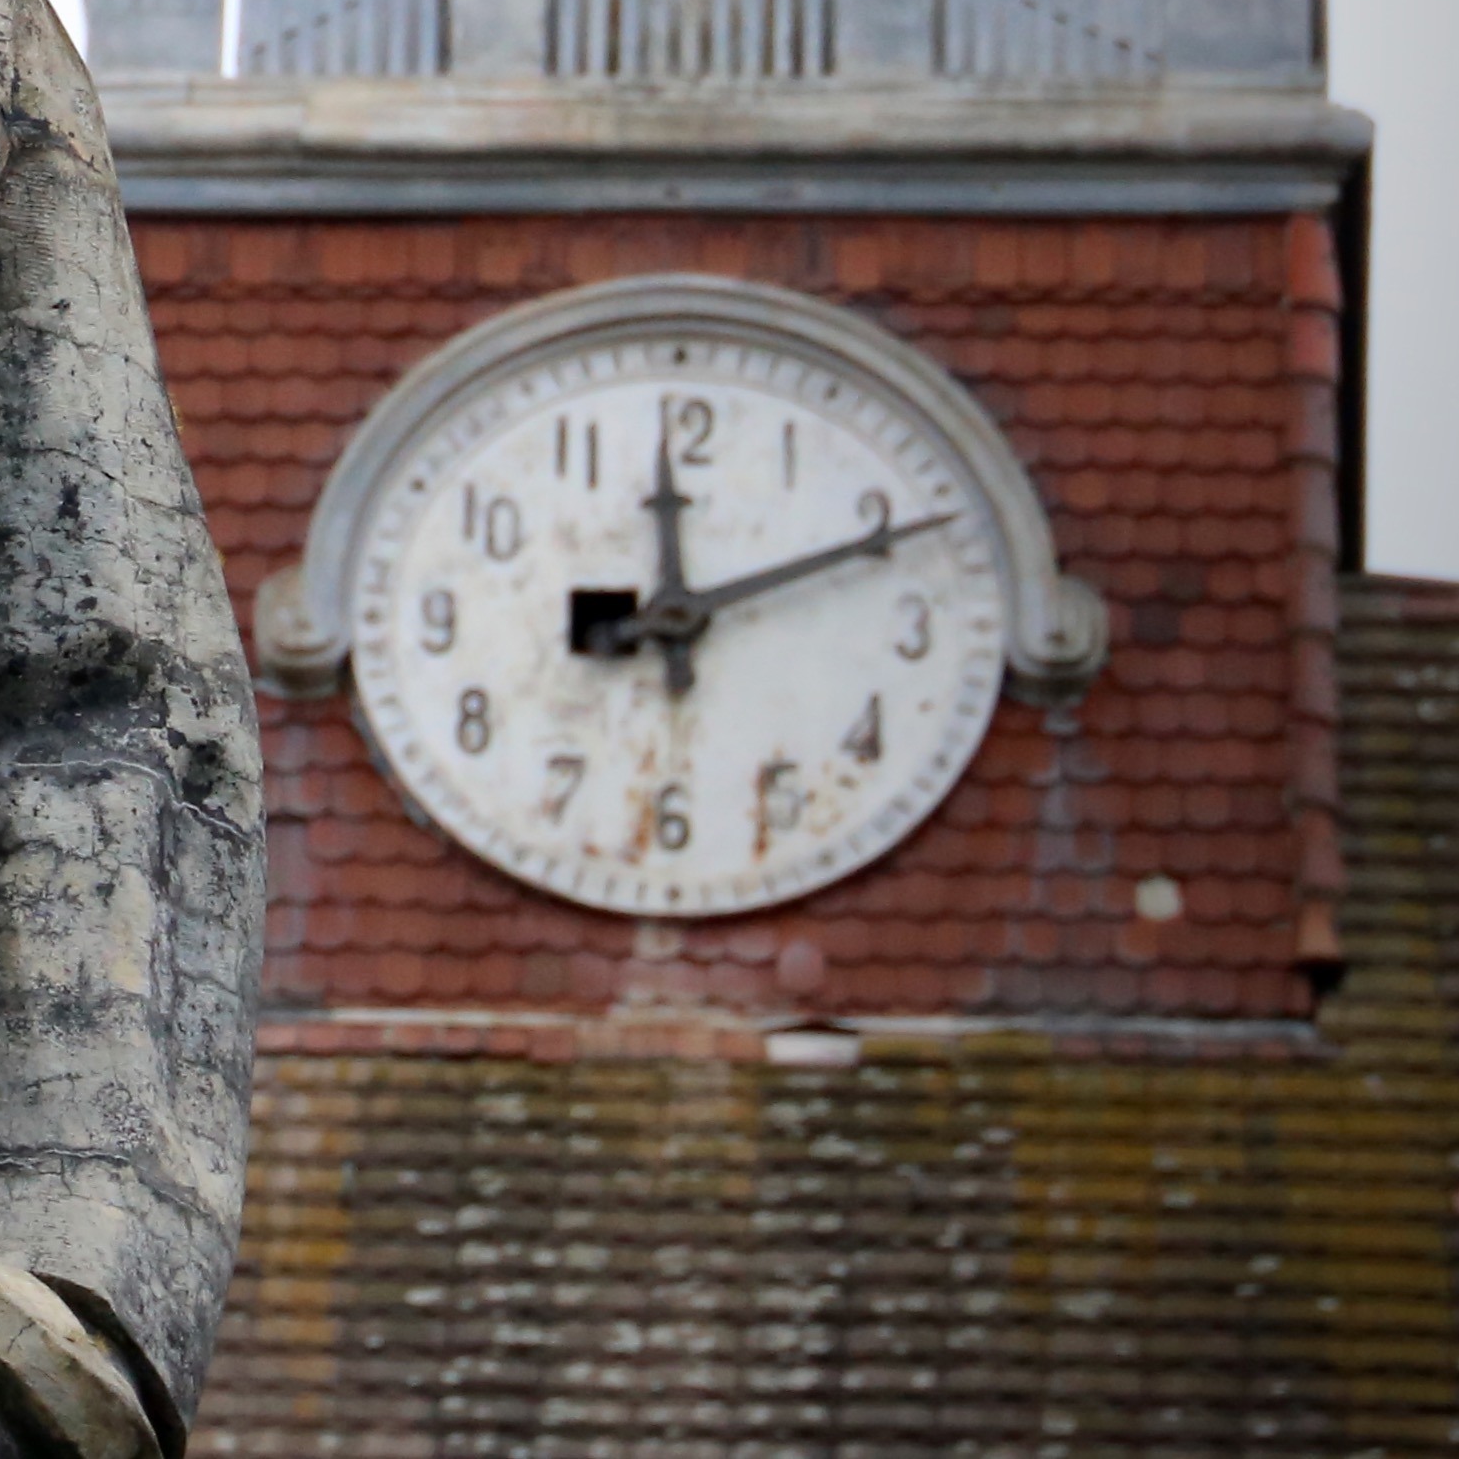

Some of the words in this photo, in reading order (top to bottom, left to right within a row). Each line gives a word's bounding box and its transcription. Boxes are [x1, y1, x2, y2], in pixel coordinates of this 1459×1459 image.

[556, 415, 599, 489] 11
[783, 421, 796, 490] 1
[461, 484, 522, 561] 10
[421, 590, 456, 654] 9
[894, 595, 932, 662] 3
[455, 689, 491, 754] 8
[841, 693, 882, 762] 4
[548, 755, 585, 825] 7
[654, 786, 690, 851] 6
[762, 761, 801, 830] 5
